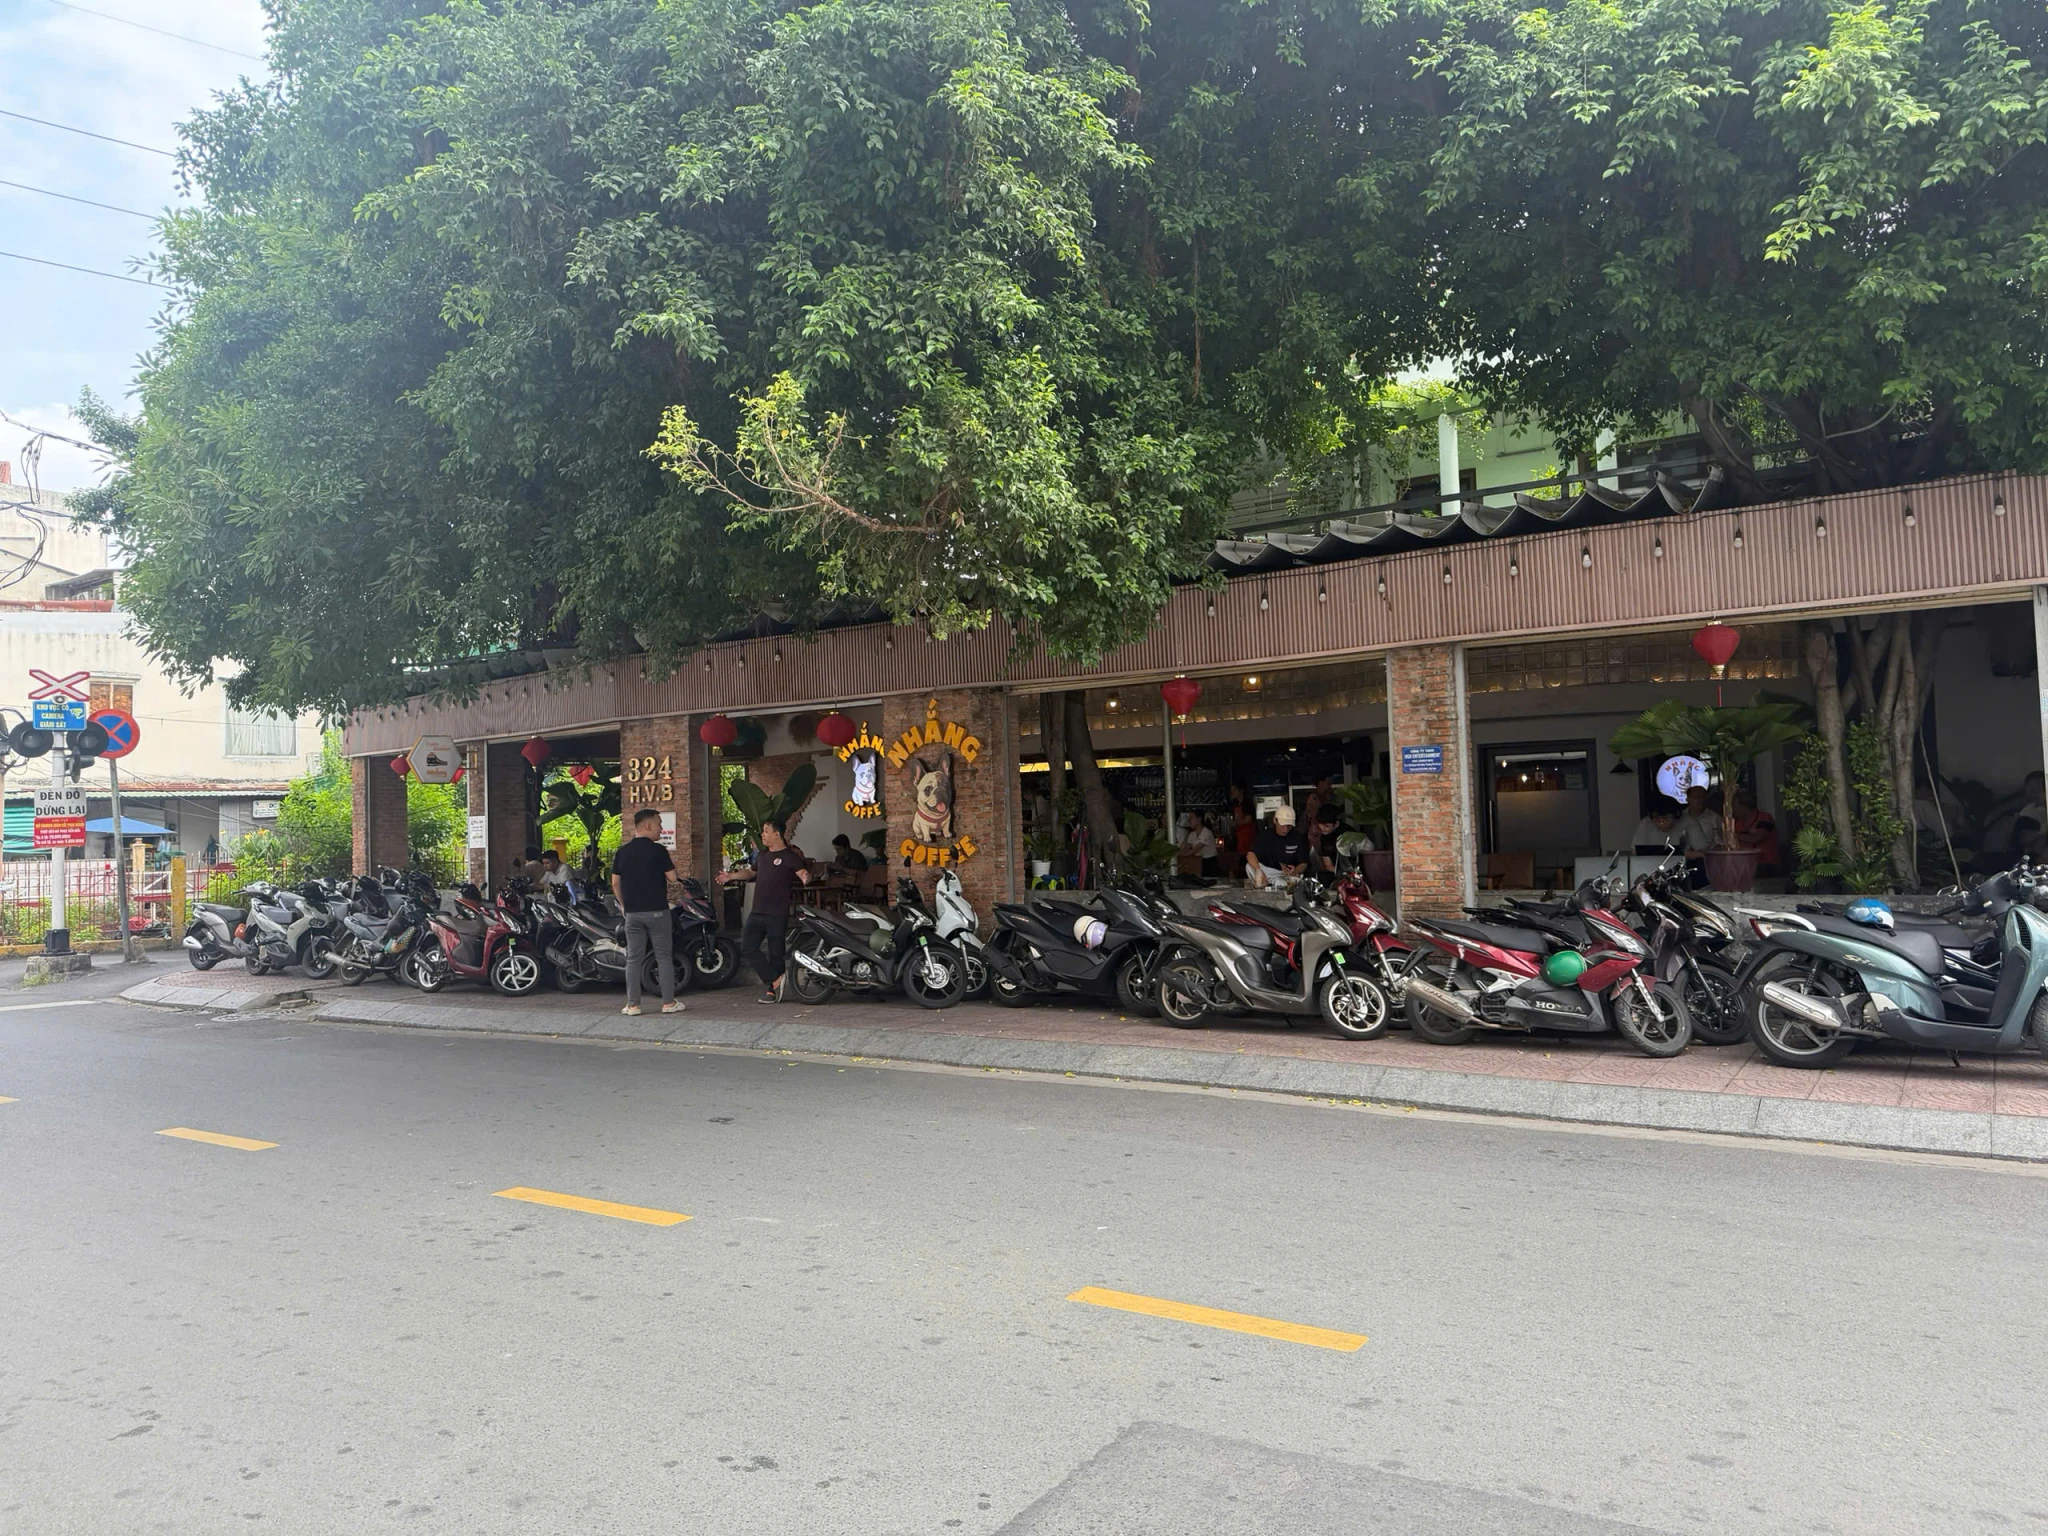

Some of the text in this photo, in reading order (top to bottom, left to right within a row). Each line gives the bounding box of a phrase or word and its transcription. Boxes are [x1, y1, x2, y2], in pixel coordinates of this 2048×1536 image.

[887, 698, 981, 768] NHẮNG
[628, 755, 672, 782] 324
[40, 789, 62, 801] ĐÈN
[629, 784, 673, 803] H.V.B
[69, 805, 85, 816] LẠI
